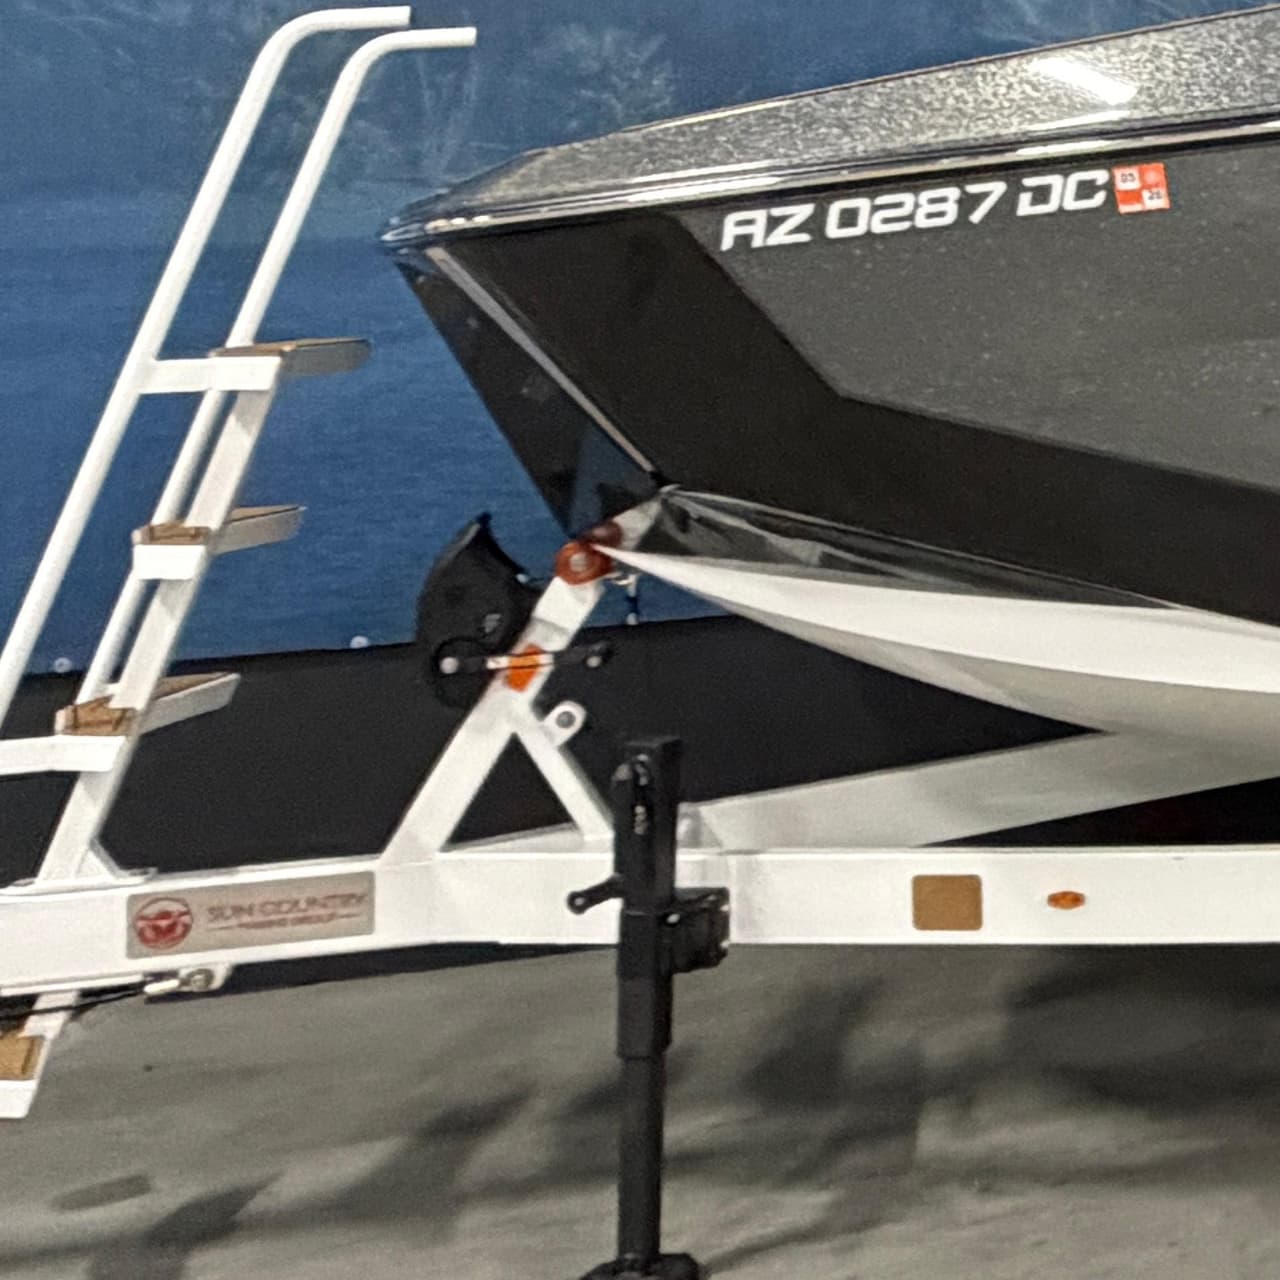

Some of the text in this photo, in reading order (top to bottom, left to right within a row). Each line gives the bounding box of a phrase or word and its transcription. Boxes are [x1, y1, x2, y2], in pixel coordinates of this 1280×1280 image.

[720, 170, 1109, 251] AZ 0287 DC
